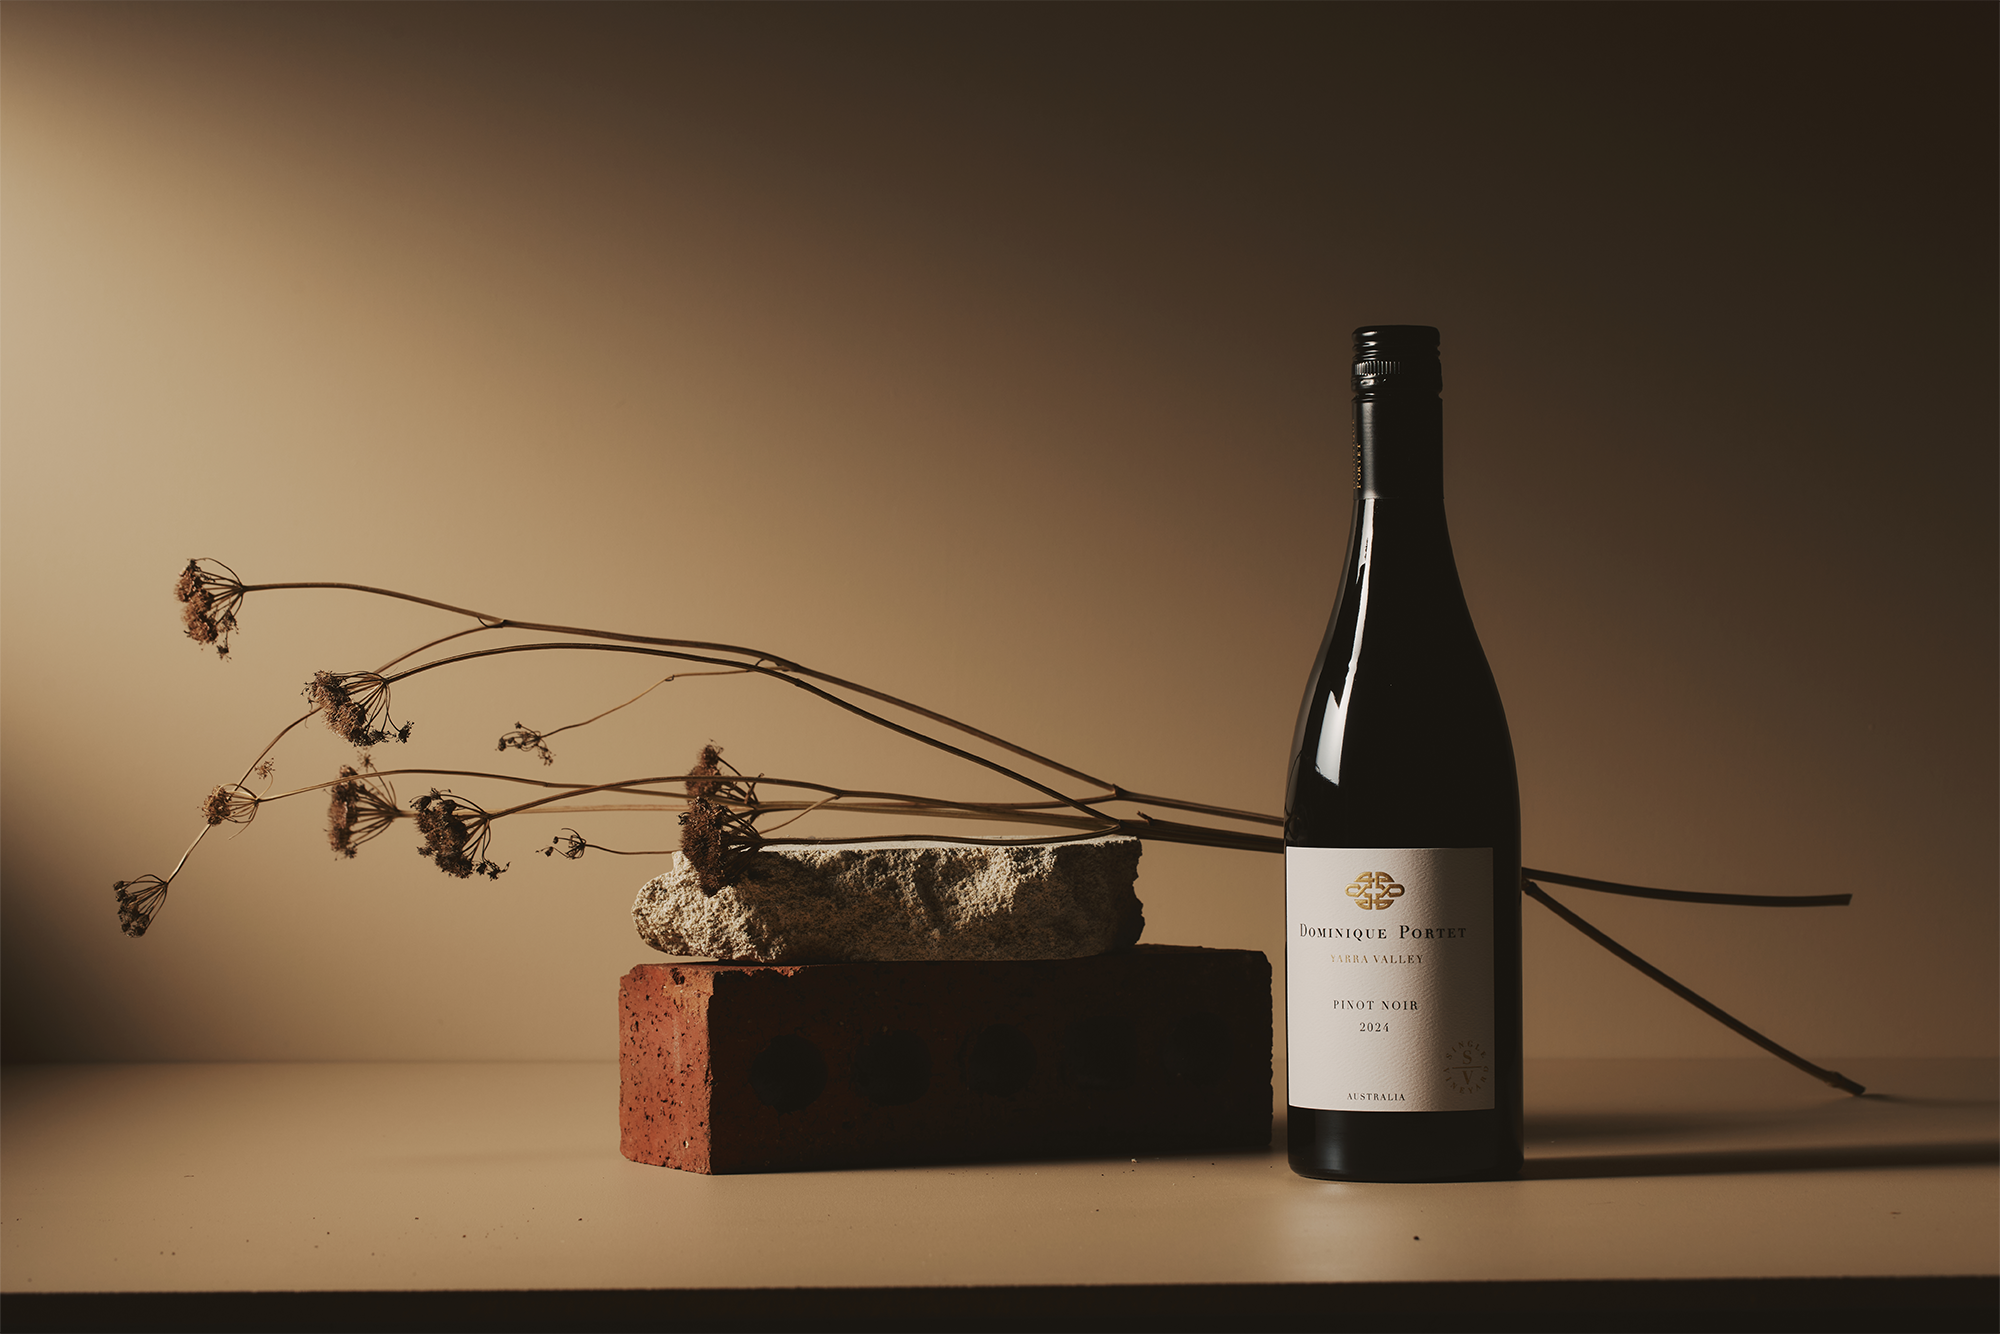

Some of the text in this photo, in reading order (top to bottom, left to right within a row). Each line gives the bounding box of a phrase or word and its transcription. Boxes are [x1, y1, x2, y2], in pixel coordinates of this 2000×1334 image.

[1300, 924, 1467, 941] DOMINIQUE PORTET
[1331, 954, 1424, 963] YARRA VALLEY
[1333, 1000, 1418, 1010] PINOT NOIR
[1359, 1022, 1389, 1032] 2024
[1446, 1040, 1487, 1059] SINGLE
[1462, 1050, 1472, 1065] S
[1443, 1066, 1489, 1094] VINEYARD
[1462, 1070, 1474, 1085] V
[1347, 1093, 1405, 1101] AUSTRALIA
